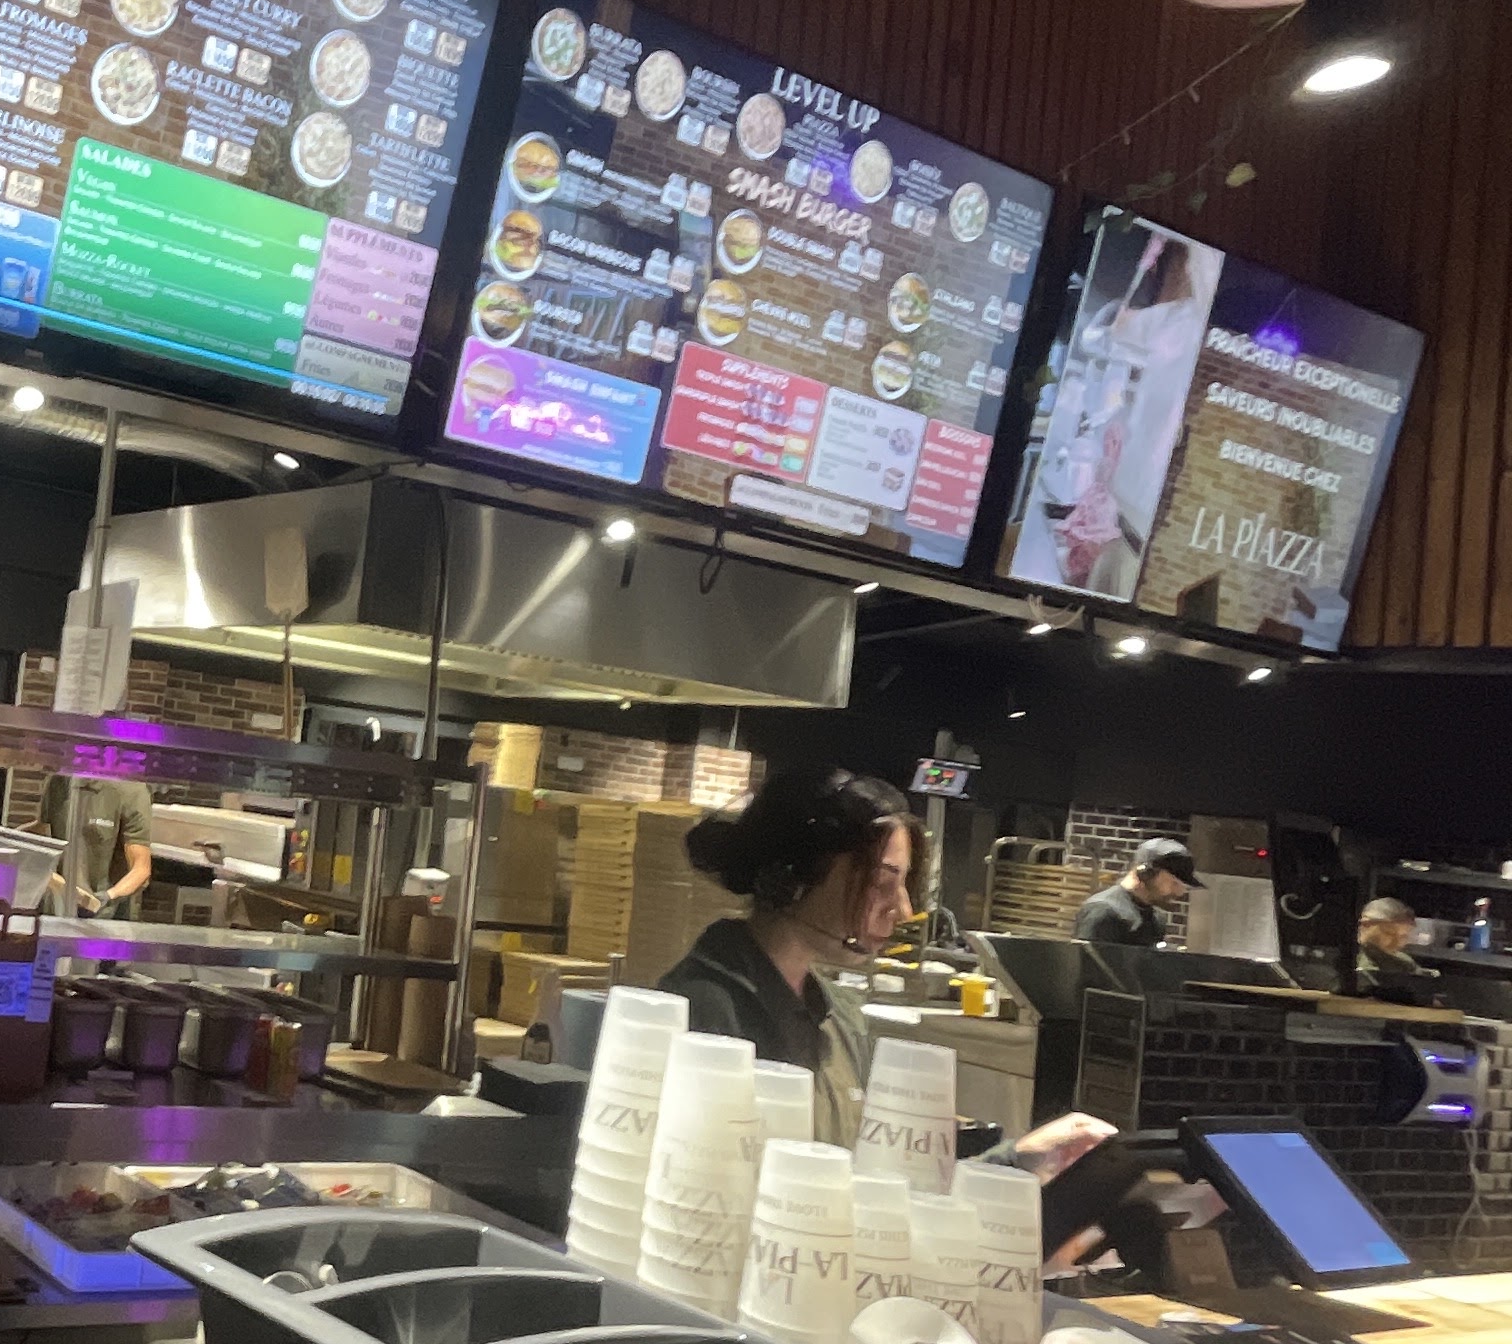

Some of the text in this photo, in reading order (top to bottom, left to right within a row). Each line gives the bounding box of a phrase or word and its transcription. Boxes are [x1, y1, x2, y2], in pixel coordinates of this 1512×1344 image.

[0, 0, 89, 47] FROMAGES
[769, 65, 849, 123] LEVEL
[845, 97, 881, 137] UP
[725, 163, 797, 216] SMASH
[793, 190, 875, 247] BURGER
[1203, 379, 1278, 424] SAVEURS
[1217, 437, 1342, 494] BIENVENUE CHEZ
[1187, 505, 1333, 580] LA PIAZZA
